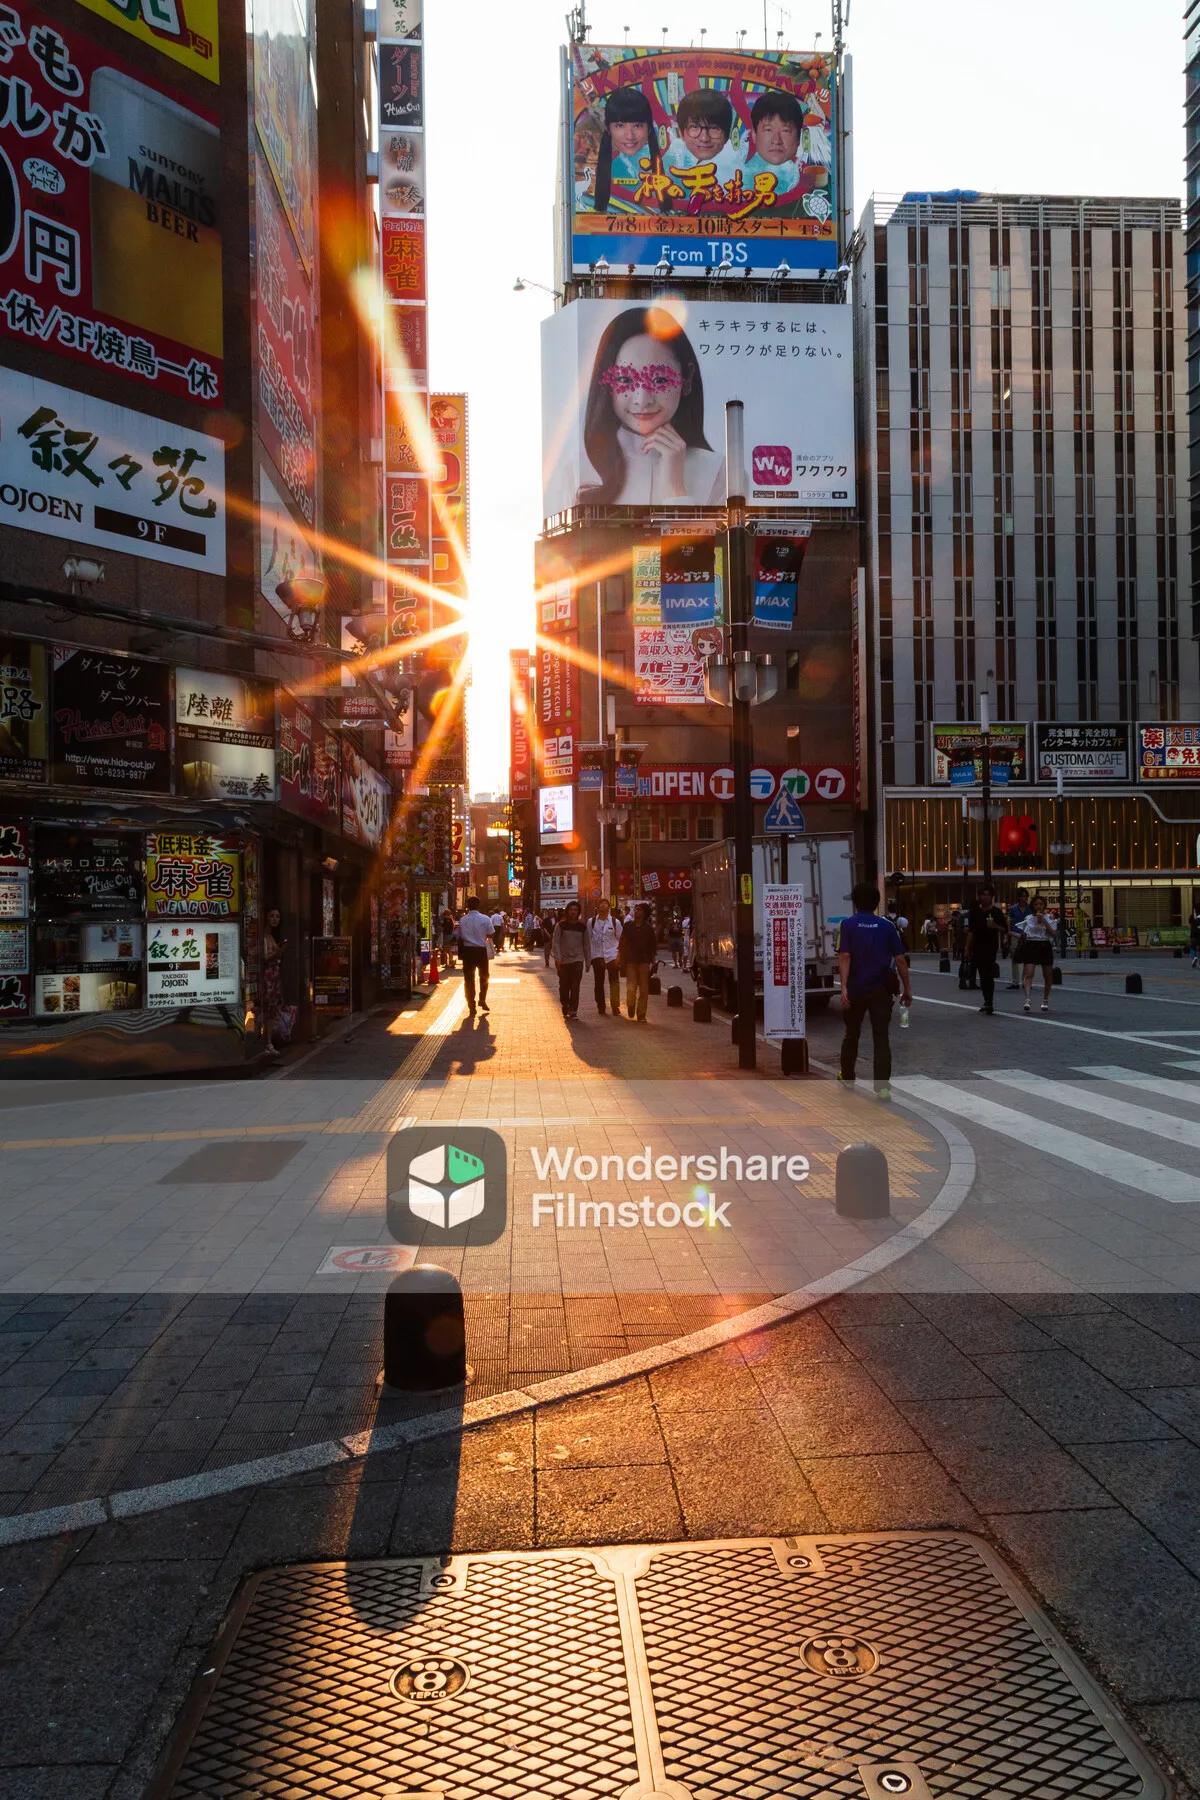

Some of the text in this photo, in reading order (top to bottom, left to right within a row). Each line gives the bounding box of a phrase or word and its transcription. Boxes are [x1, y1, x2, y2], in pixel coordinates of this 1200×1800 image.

[390, 46, 410, 102] ダーツ
[146, 198, 199, 244] BEER
[661, 242, 748, 263] From TBS
[385, 233, 424, 292] 麻雀
[698, 319, 828, 335] キラキラするには、
[0, 289, 219, 399] 休/3F焼鳥一休
[698, 343, 843, 360] ワクワクが足りない。
[796, 465, 848, 477] ワクワク
[665, 571, 711, 583] シン・ゴジラ
[759, 570, 797, 583] シン・ゴジラ
[665, 597, 710, 609] IMAX
[755, 595, 790, 608] IMAX
[639, 630, 666, 643] 女性
[638, 645, 697, 656] 高収入求人
[80, 657, 141, 680] ダイニング
[116, 680, 126, 691] &
[542, 643, 552, 722] ロッケクラブ
[99, 689, 161, 707] ダーツバー
[187, 692, 234, 722] 陸離
[1043, 753, 1123, 766] CUSTOMA CAFE
[1143, 751, 1163, 766] 6F
[76, 765, 88, 776] TEL
[545, 767, 573, 777] OPEN
[250, 772, 274, 799] 奏
[651, 771, 705, 797] OPEN
[157, 835, 210, 856] 低料金
[150, 859, 234, 897] 麻雀
[156, 899, 230, 915] WELCOME
[148, 938, 202, 959] 叙々苑
[160, 979, 190, 989] JOJOEN
